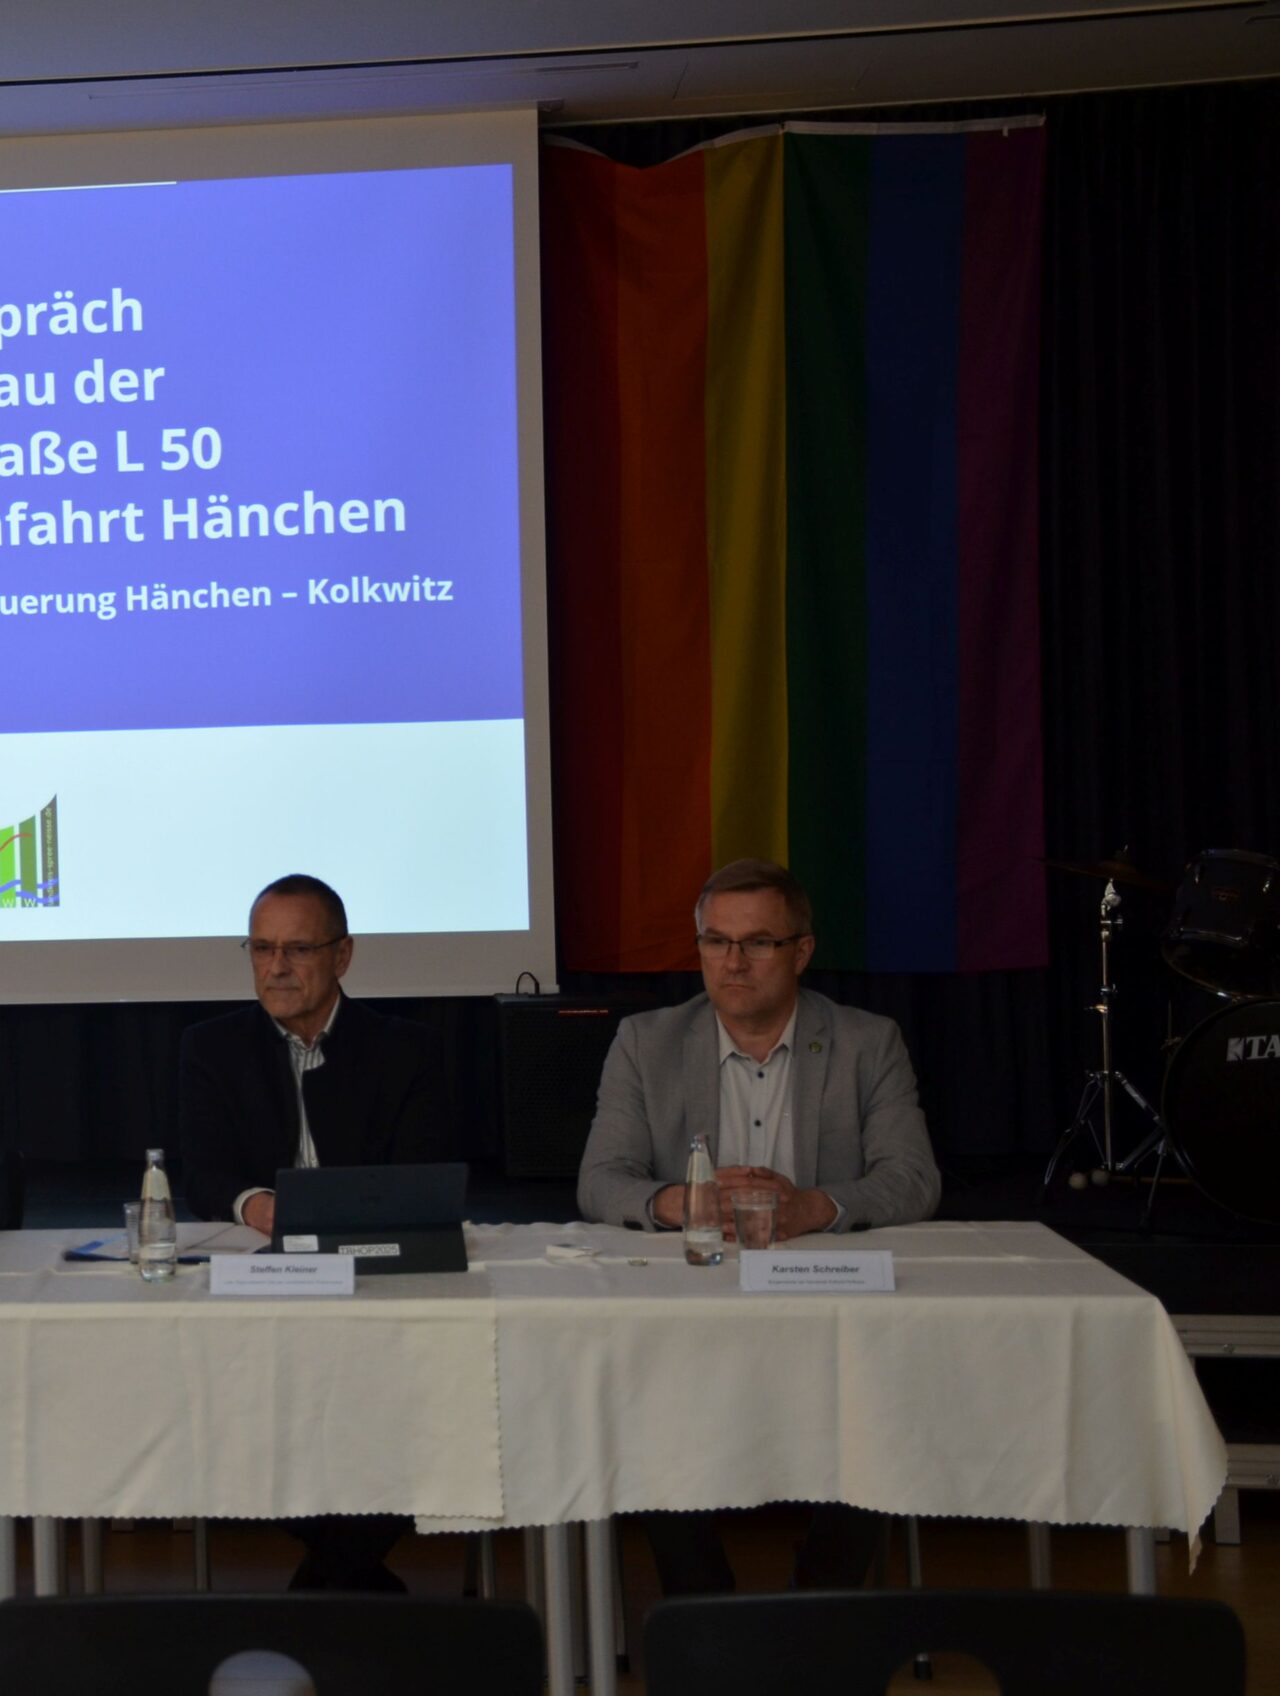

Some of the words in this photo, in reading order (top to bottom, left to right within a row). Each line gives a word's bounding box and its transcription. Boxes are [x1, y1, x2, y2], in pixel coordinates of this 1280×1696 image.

[74, 358, 166, 404] der
[116, 430, 145, 472] L
[161, 426, 222, 471] 50
[163, 490, 407, 541] Hänchen
[126, 581, 272, 612] Hänchen
[308, 573, 455, 605] Kolkwitz
[249, 1264, 283, 1274] Steffen
[284, 1264, 319, 1274] Kleiner
[771, 1264, 810, 1274] Karsten
[811, 1264, 861, 1274] Schreiber
